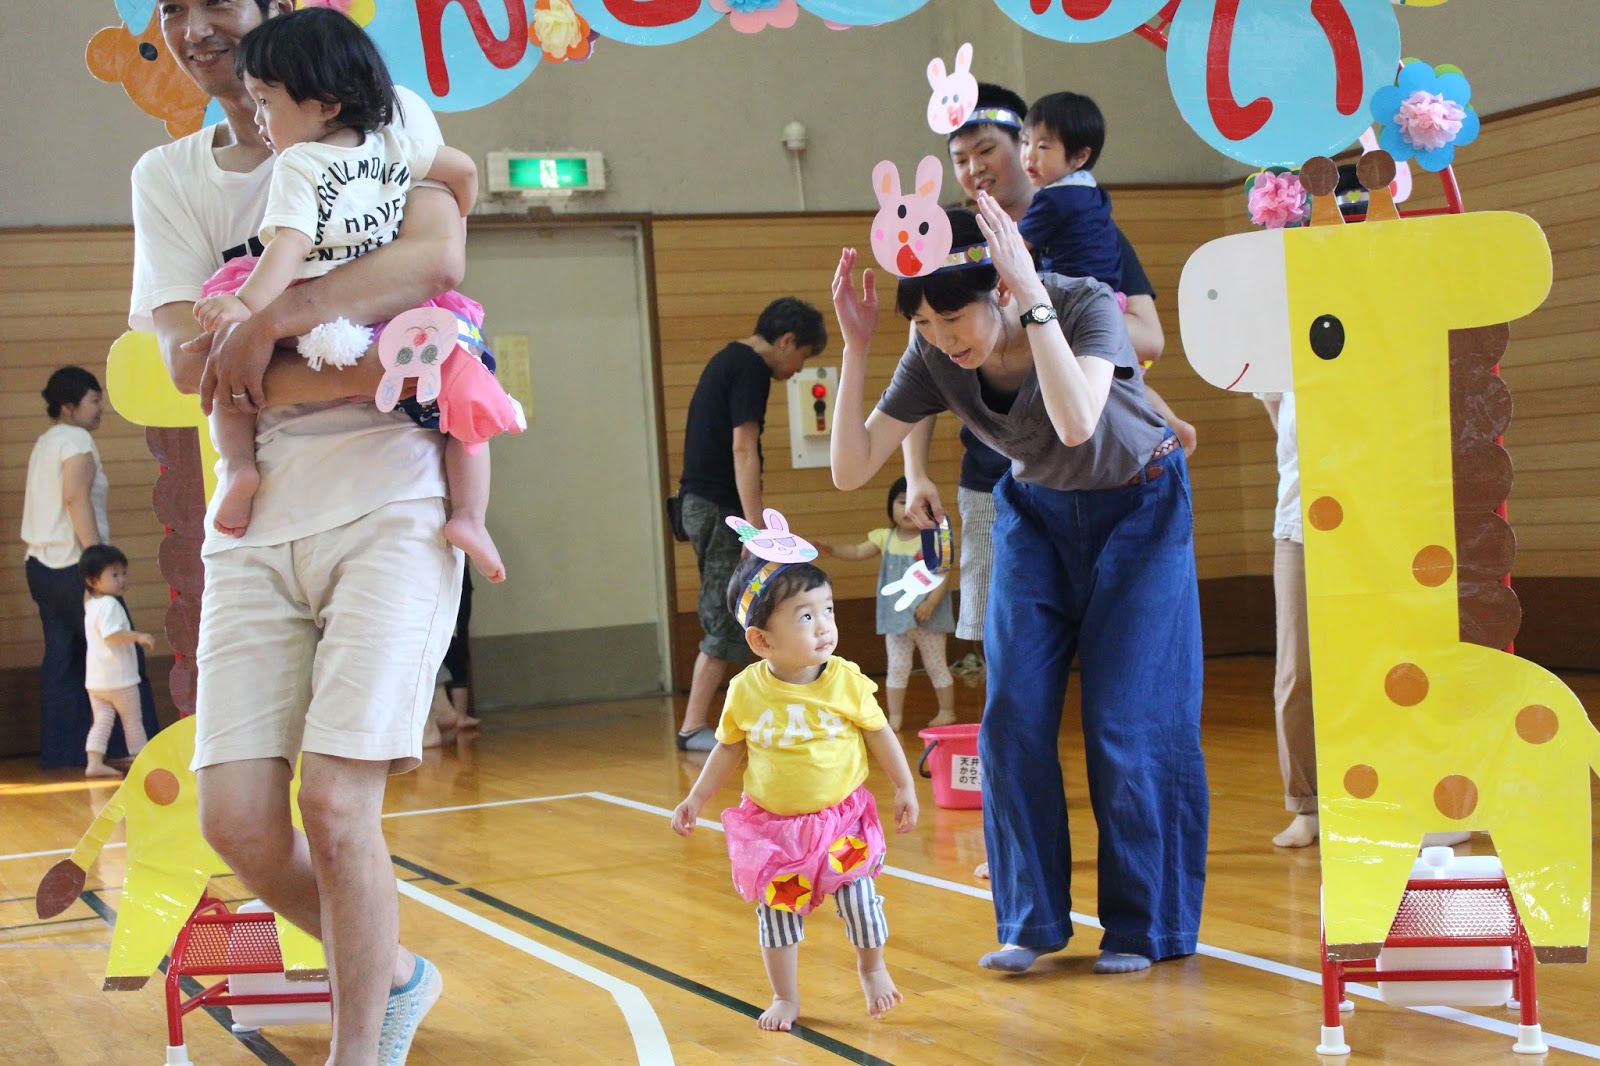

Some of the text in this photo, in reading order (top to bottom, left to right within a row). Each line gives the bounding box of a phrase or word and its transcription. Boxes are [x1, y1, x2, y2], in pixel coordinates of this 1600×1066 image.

[750, 703, 845, 749] GAP
[960, 757, 980, 766] 天井
[960, 766, 982, 776] から
